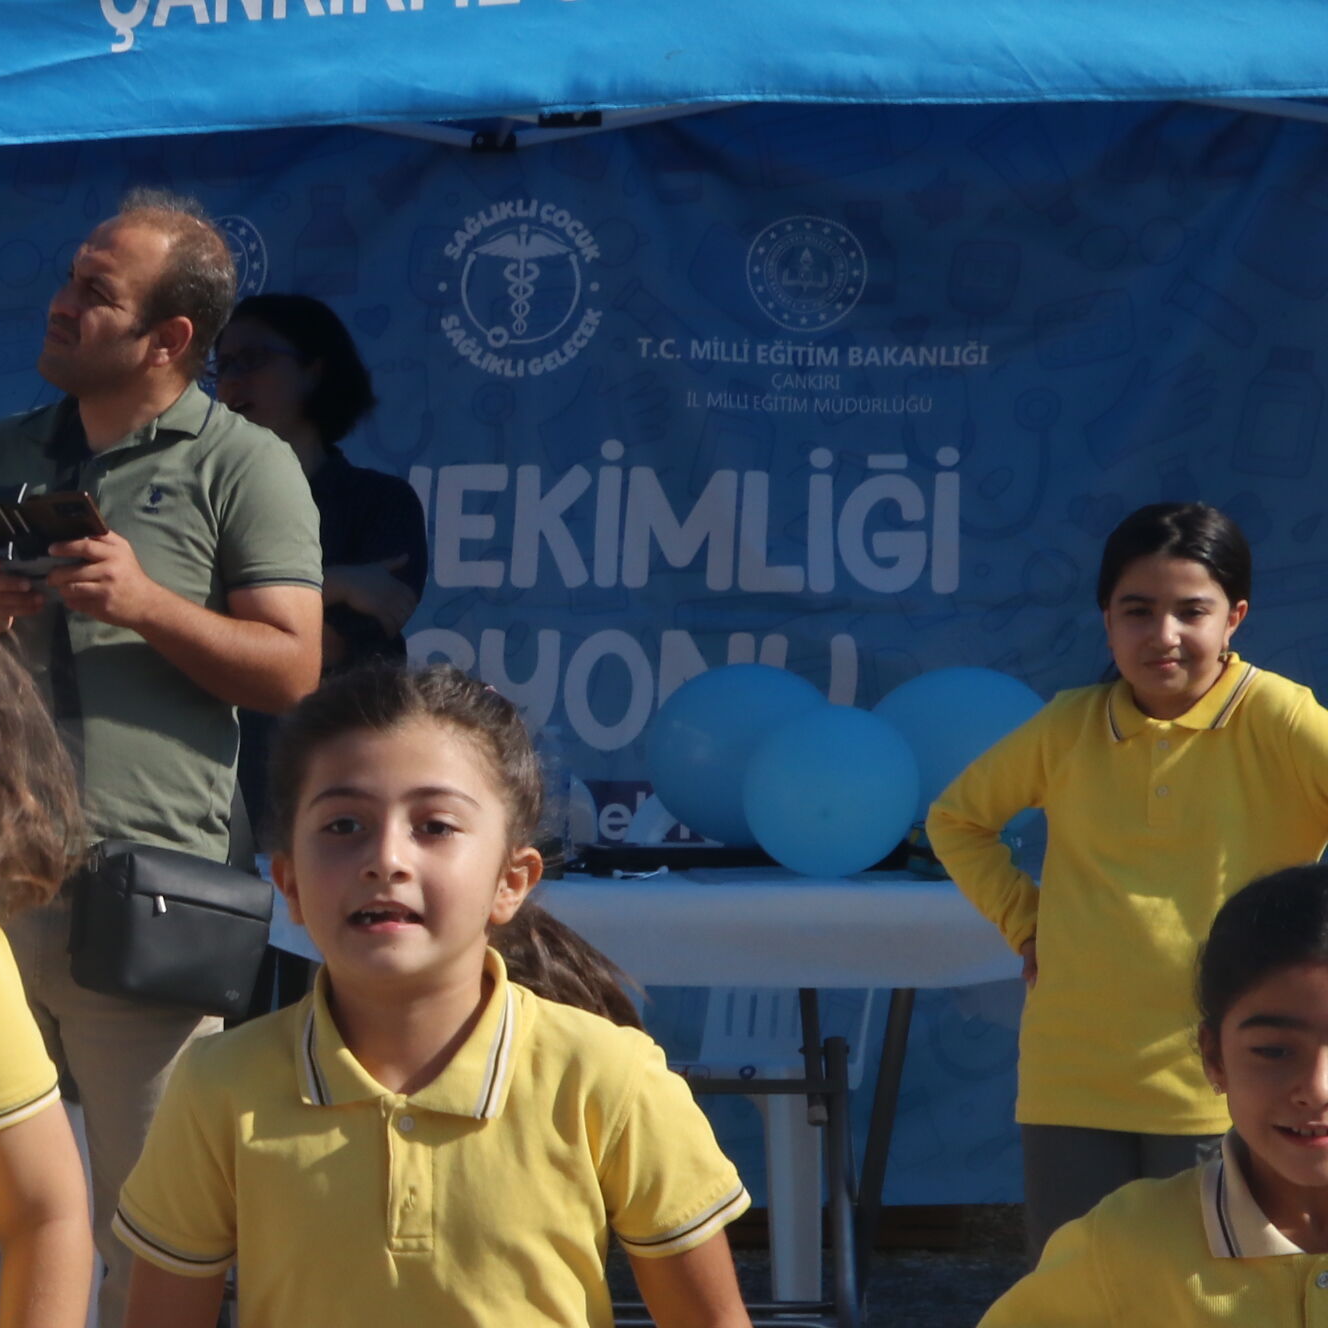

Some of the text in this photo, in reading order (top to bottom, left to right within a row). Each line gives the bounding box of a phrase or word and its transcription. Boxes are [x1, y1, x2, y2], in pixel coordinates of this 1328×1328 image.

[528, 308, 603, 376] GELECEK
[638, 336, 989, 367] T.C. MİLLİ EĞİTİM BAKANLIĞI
[410, 439, 960, 595] EKİMLİĞİ
